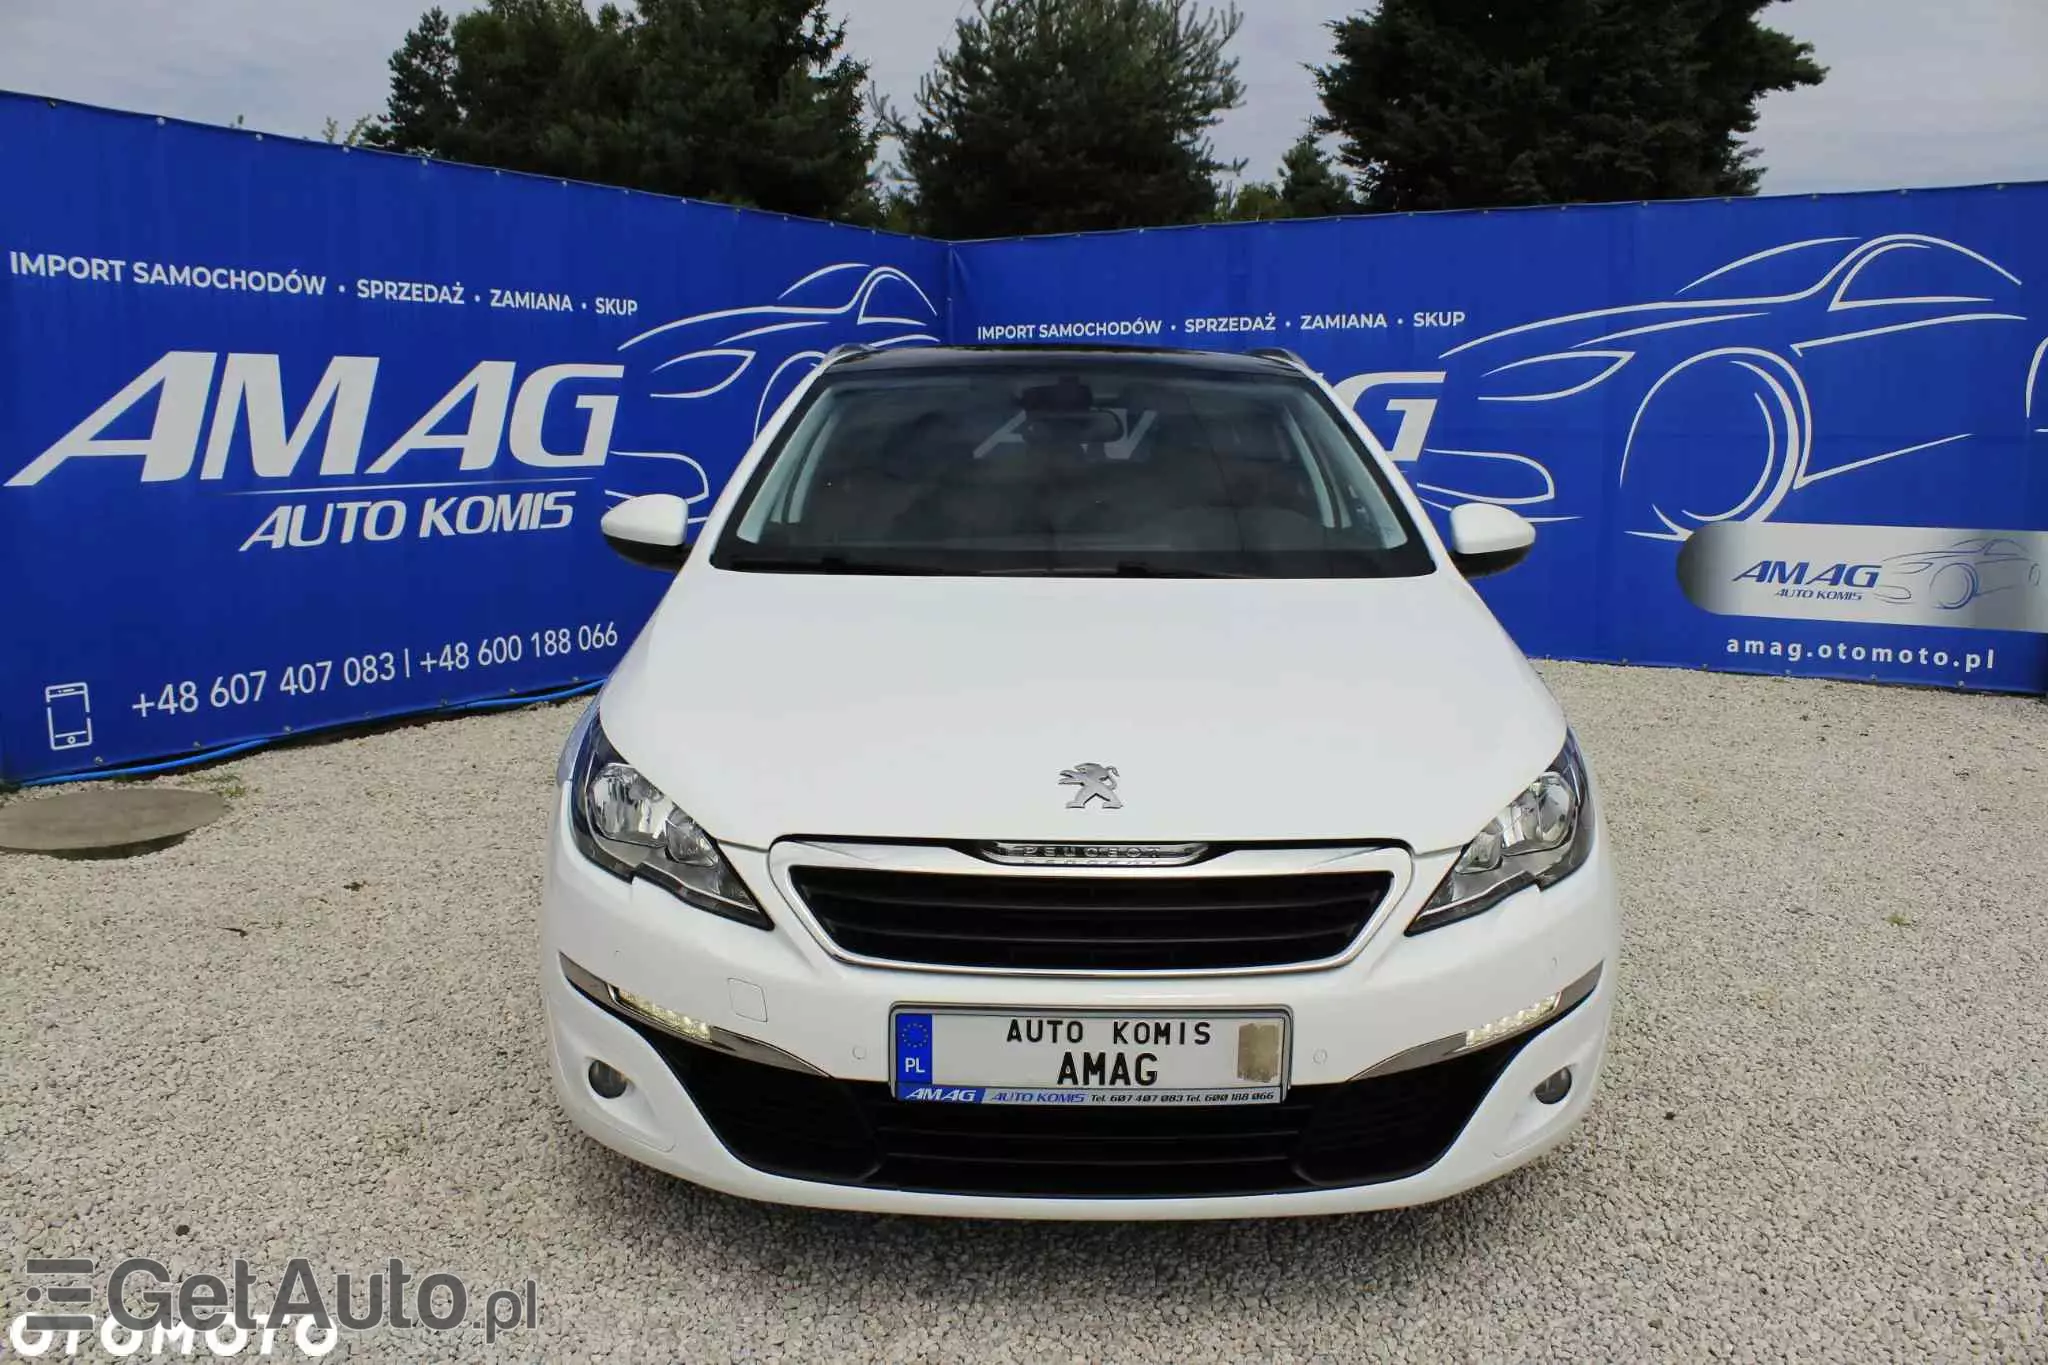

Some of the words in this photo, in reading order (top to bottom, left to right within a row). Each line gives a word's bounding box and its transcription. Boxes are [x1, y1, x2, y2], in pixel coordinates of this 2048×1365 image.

[9, 250, 126, 283] IMPORT
[132, 260, 326, 297] SAMOCHODÓW
[356, 278, 465, 305] SPRZEDAŻ
[489, 288, 573, 312] ZAMIANA
[595, 296, 638, 316] SKUP
[977, 323, 1036, 340] IMPORT
[1039, 318, 1162, 339] SAMOCHODÓW
[1184, 312, 1277, 333] SPRZEDAŻ
[1300, 313, 1387, 330] ZAMIANA
[1412, 311, 1466, 328] SKUP
[4, 350, 624, 487] AMAG
[238, 500, 406, 552] AUTO
[418, 491, 577, 539] KOMIS
[1732, 560, 1882, 588] AMAG
[1774, 588, 1814, 598] AUTO
[1816, 590, 1863, 601] KOMIS
[132, 681, 198, 718] +48
[210, 671, 267, 707] 607
[279, 661, 333, 697] 407
[343, 652, 396, 686] 083
[419, 643, 469, 673] +48
[478, 636, 523, 666] 600
[531, 628, 571, 657] 188
[578, 621, 618, 648] 066
[1726, 637, 1995, 673] amag.otomoto.pl
[1006, 1019, 1084, 1044] AUTO
[1113, 1021, 1212, 1045] KOMIS
[904, 1057, 926, 1073] PL
[1057, 1051, 1159, 1087] AMAG
[907, 1087, 976, 1102] AMAG
[991, 1092, 1033, 1103] AUTO
[1036, 1092, 1087, 1103] KOMIS
